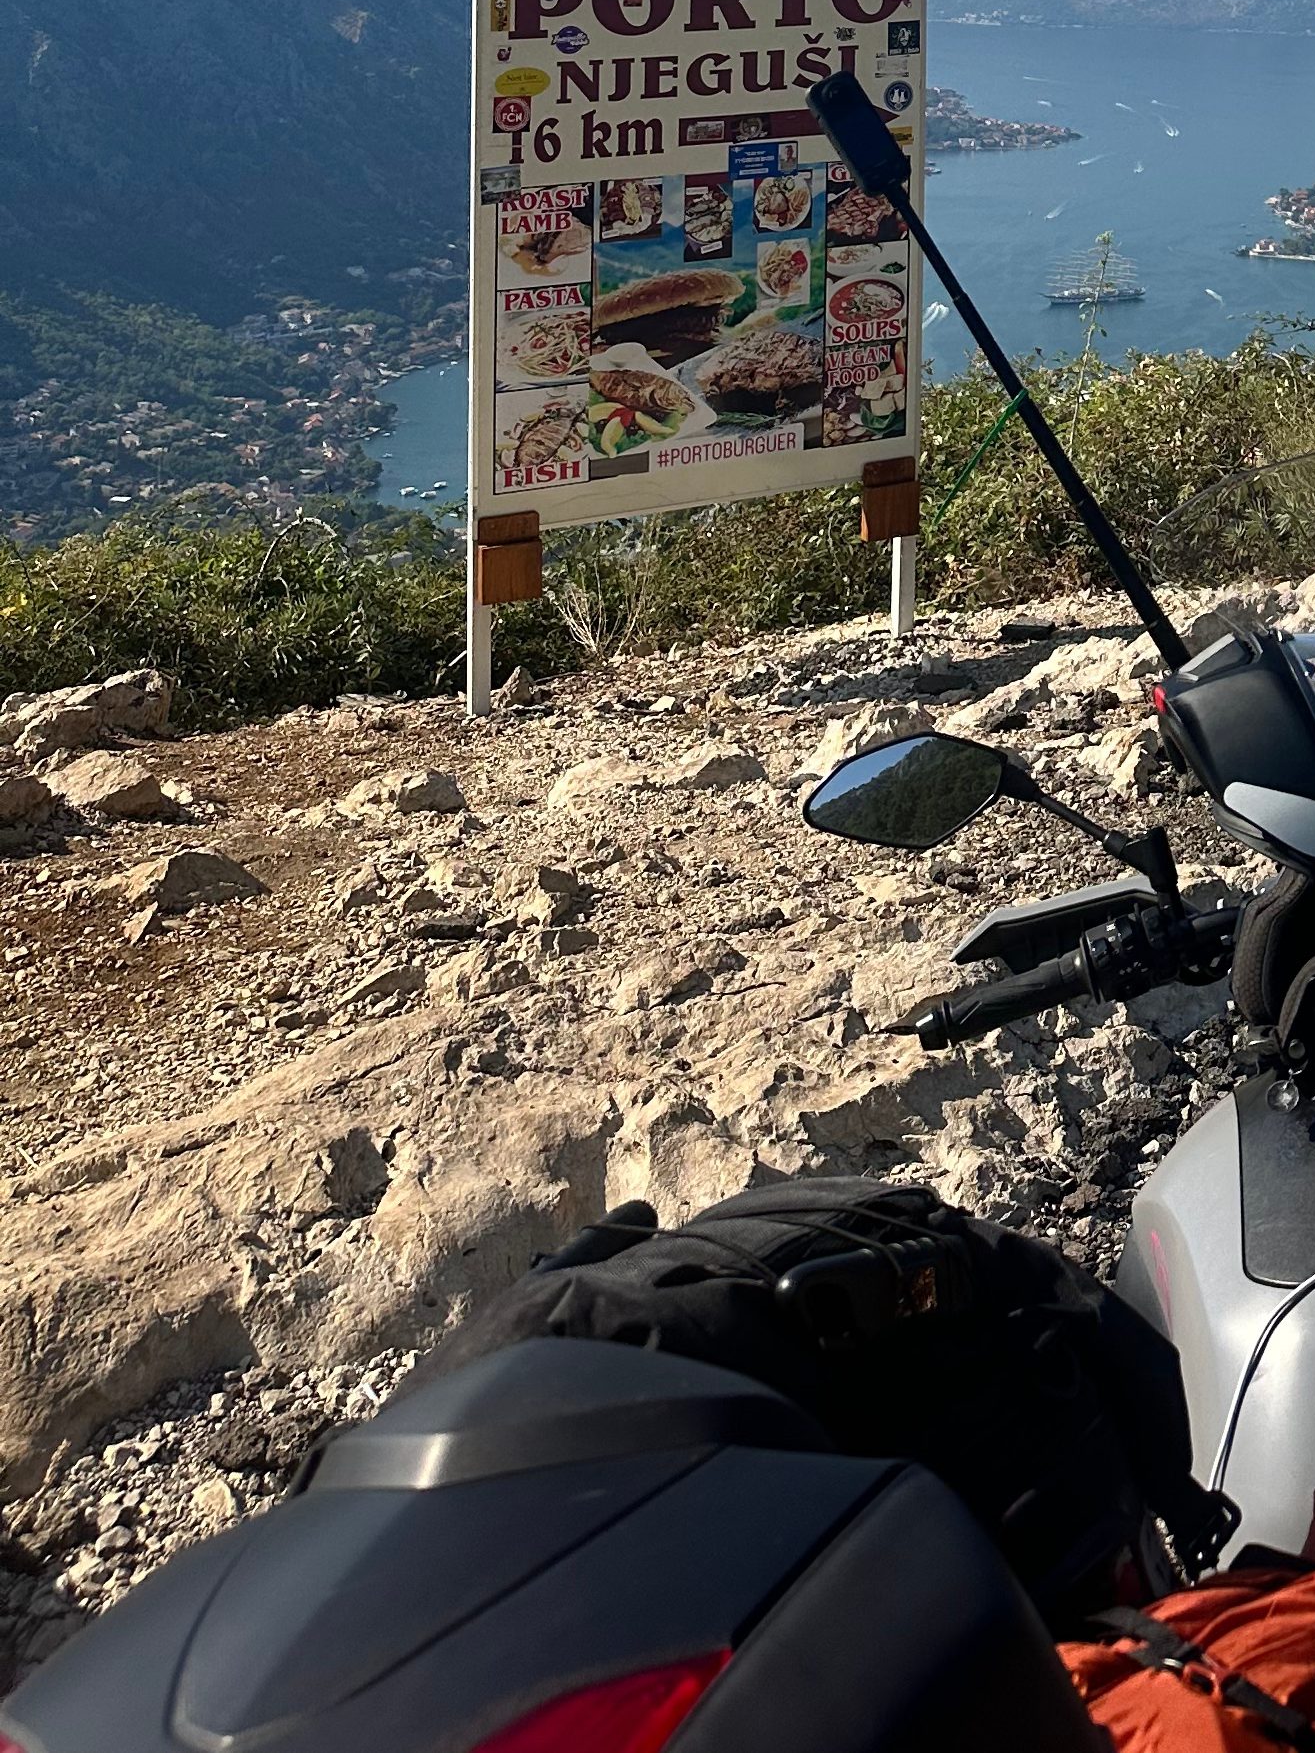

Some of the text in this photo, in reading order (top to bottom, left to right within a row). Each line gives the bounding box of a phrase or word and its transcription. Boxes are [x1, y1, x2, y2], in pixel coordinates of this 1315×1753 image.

[501, 113, 523, 123] FCN
[581, 110, 664, 159] km
[502, 212, 572, 235] LAMB
[504, 287, 582, 312] PASTA
[832, 319, 901, 343] SOUPS
[828, 346, 890, 370] VEGAN
[828, 366, 880, 387] FOOD
[657, 432, 796, 468] #PORTOBURGUER
[504, 460, 581, 488] FISH
